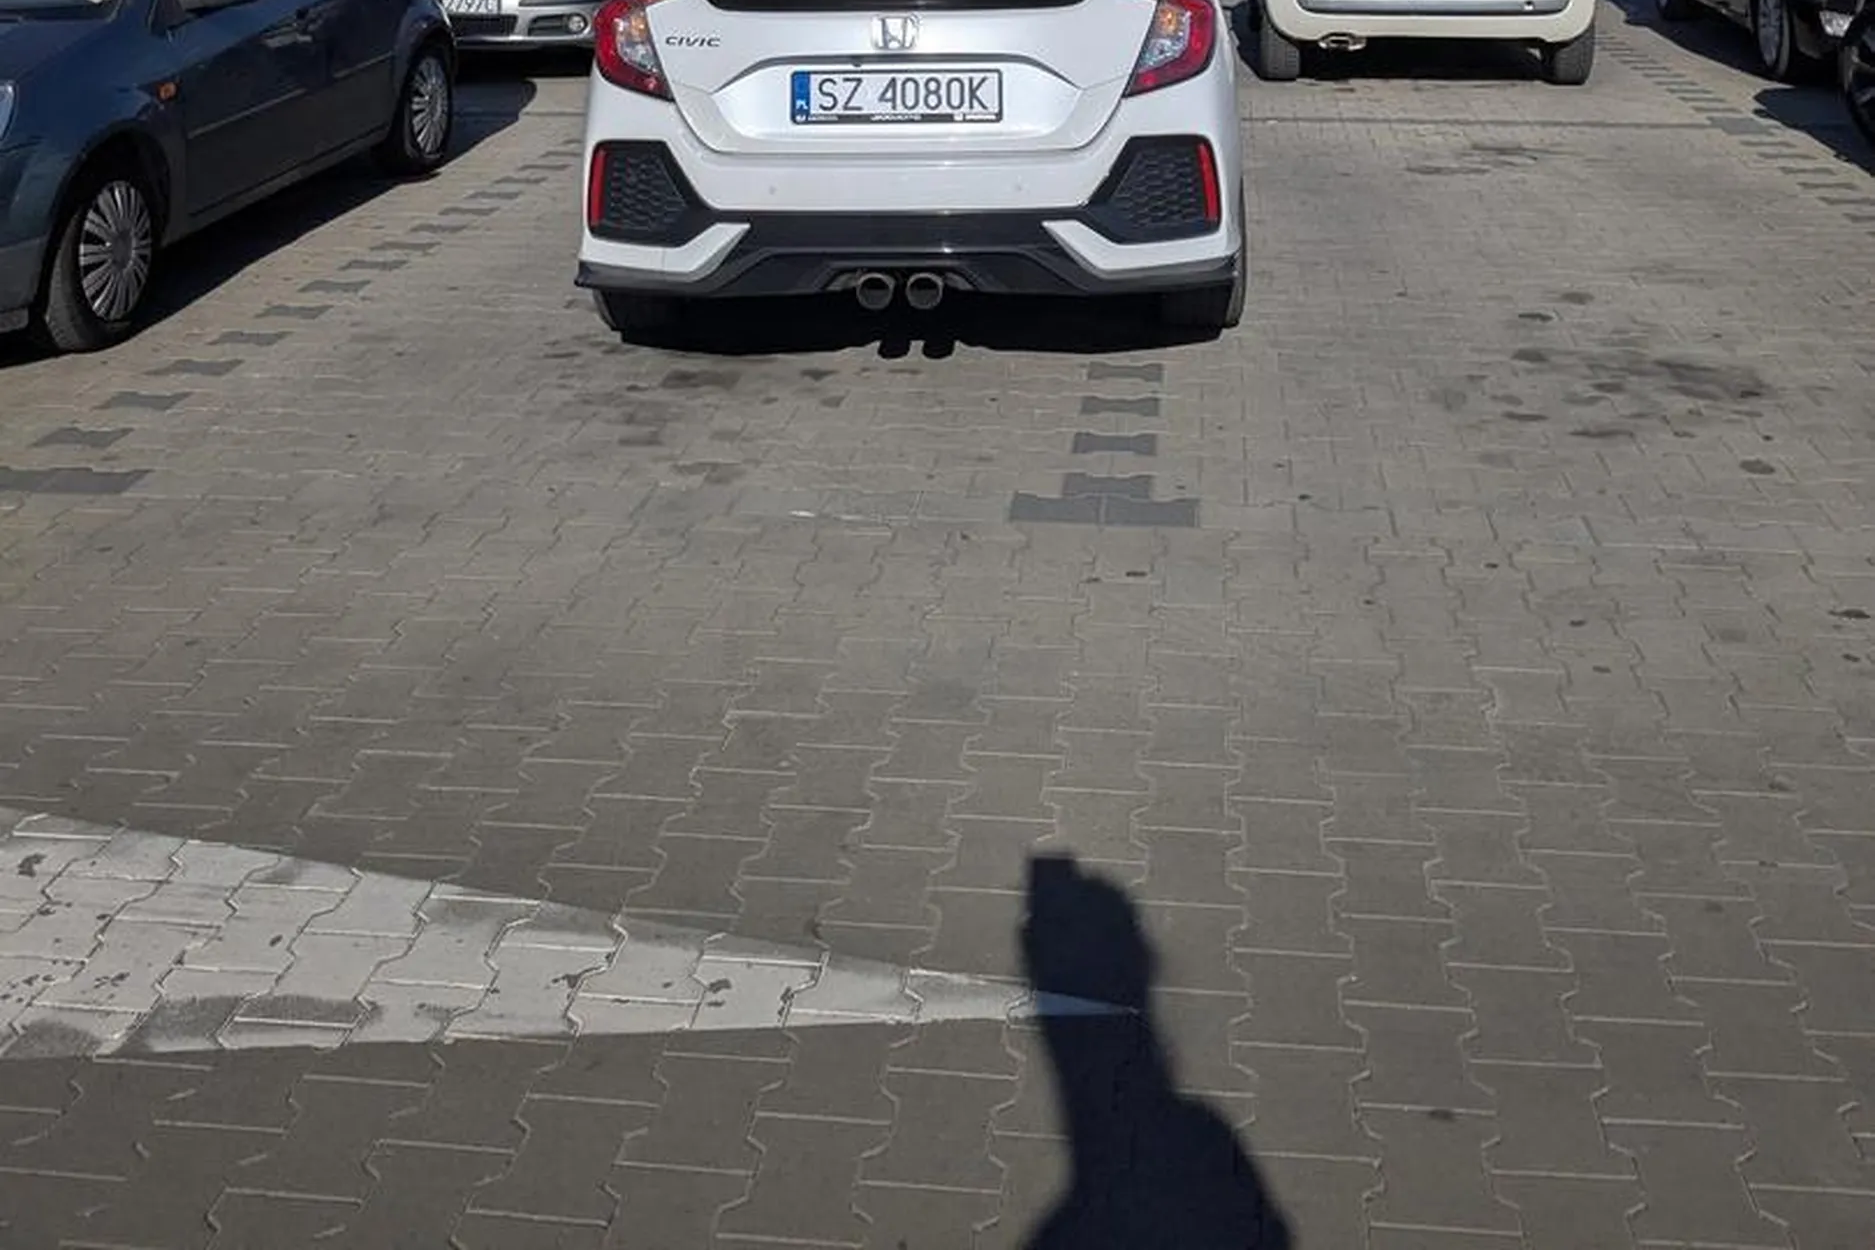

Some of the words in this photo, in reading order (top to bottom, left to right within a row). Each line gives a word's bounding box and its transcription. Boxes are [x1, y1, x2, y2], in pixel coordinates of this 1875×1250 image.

[665, 36, 721, 48] CIVIC
[818, 78, 863, 111] SZ
[878, 77, 988, 111] 4080K
